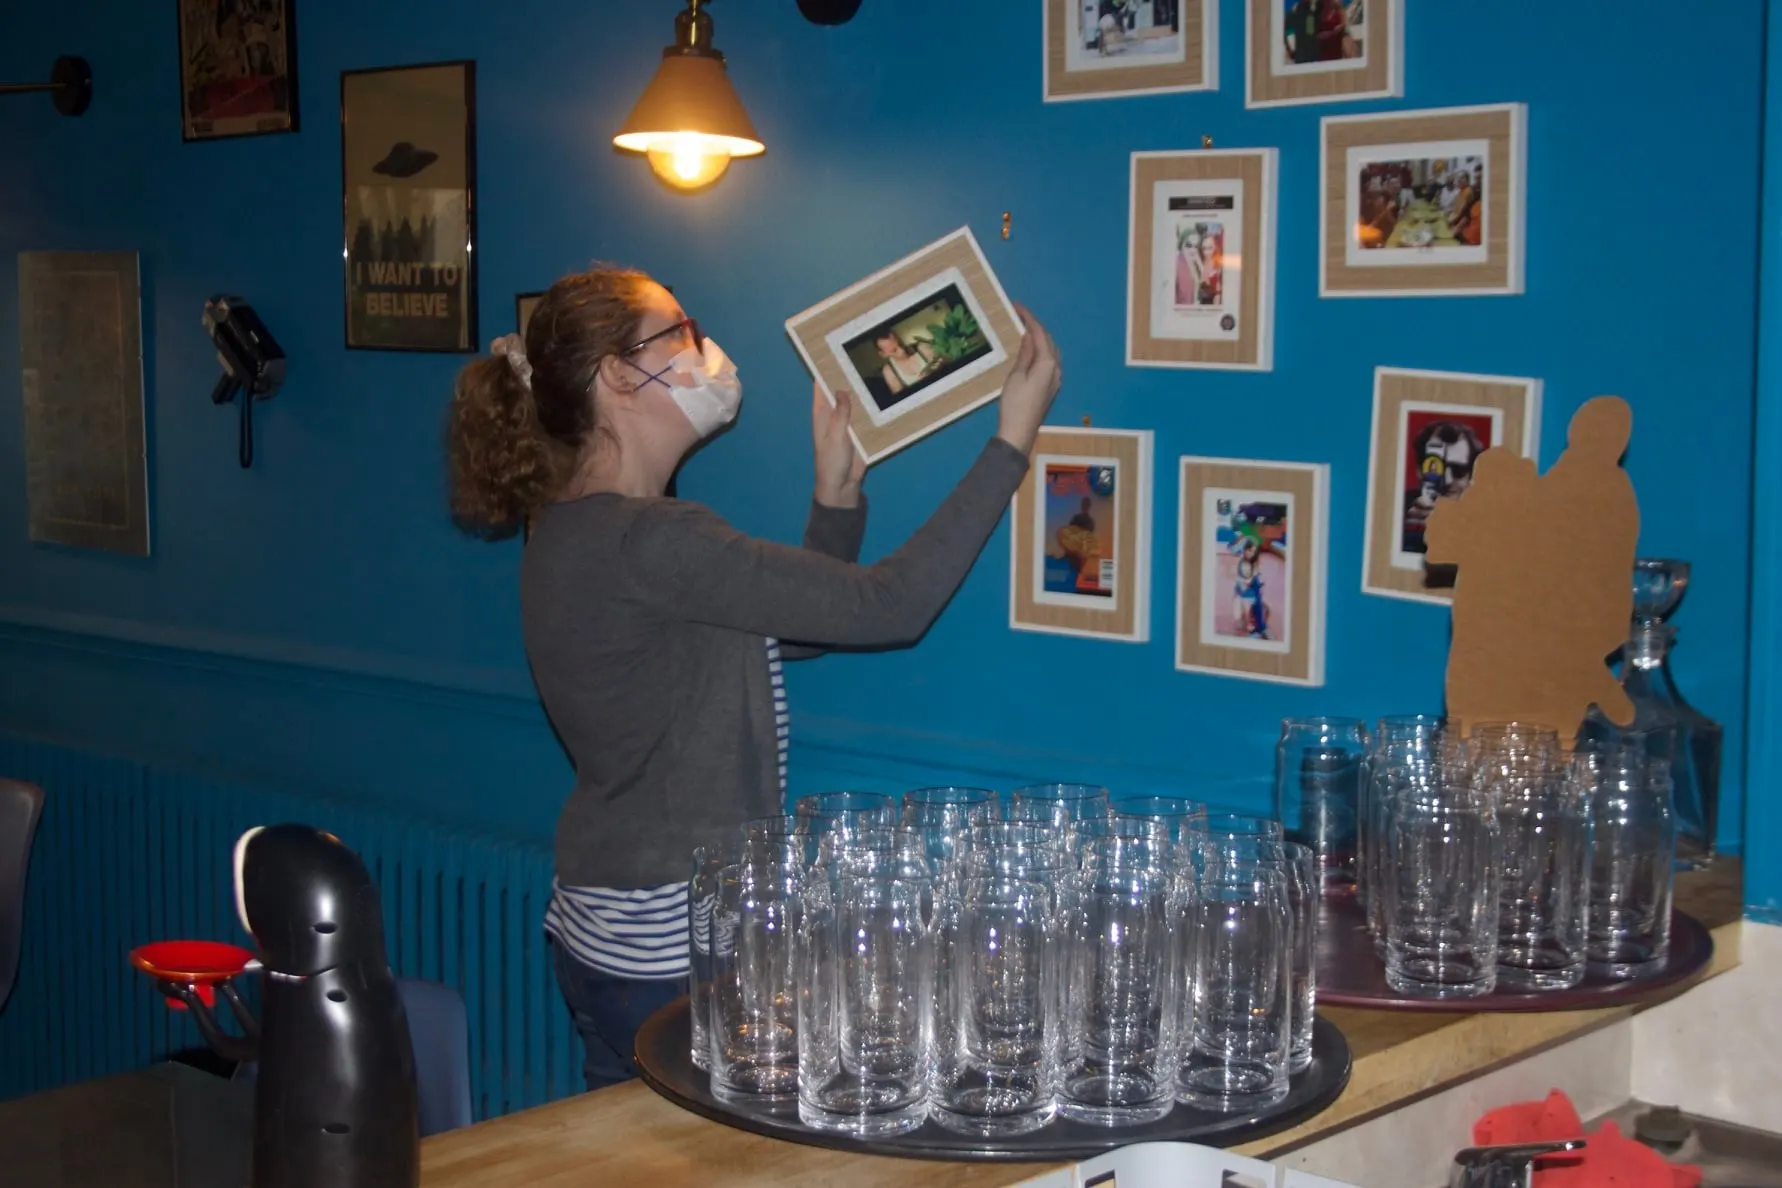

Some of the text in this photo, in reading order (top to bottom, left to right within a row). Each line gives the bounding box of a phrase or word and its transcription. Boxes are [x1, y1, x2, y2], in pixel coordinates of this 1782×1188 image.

[356, 261, 458, 286] I WANT TO
[365, 292, 449, 317] BELIEVE
